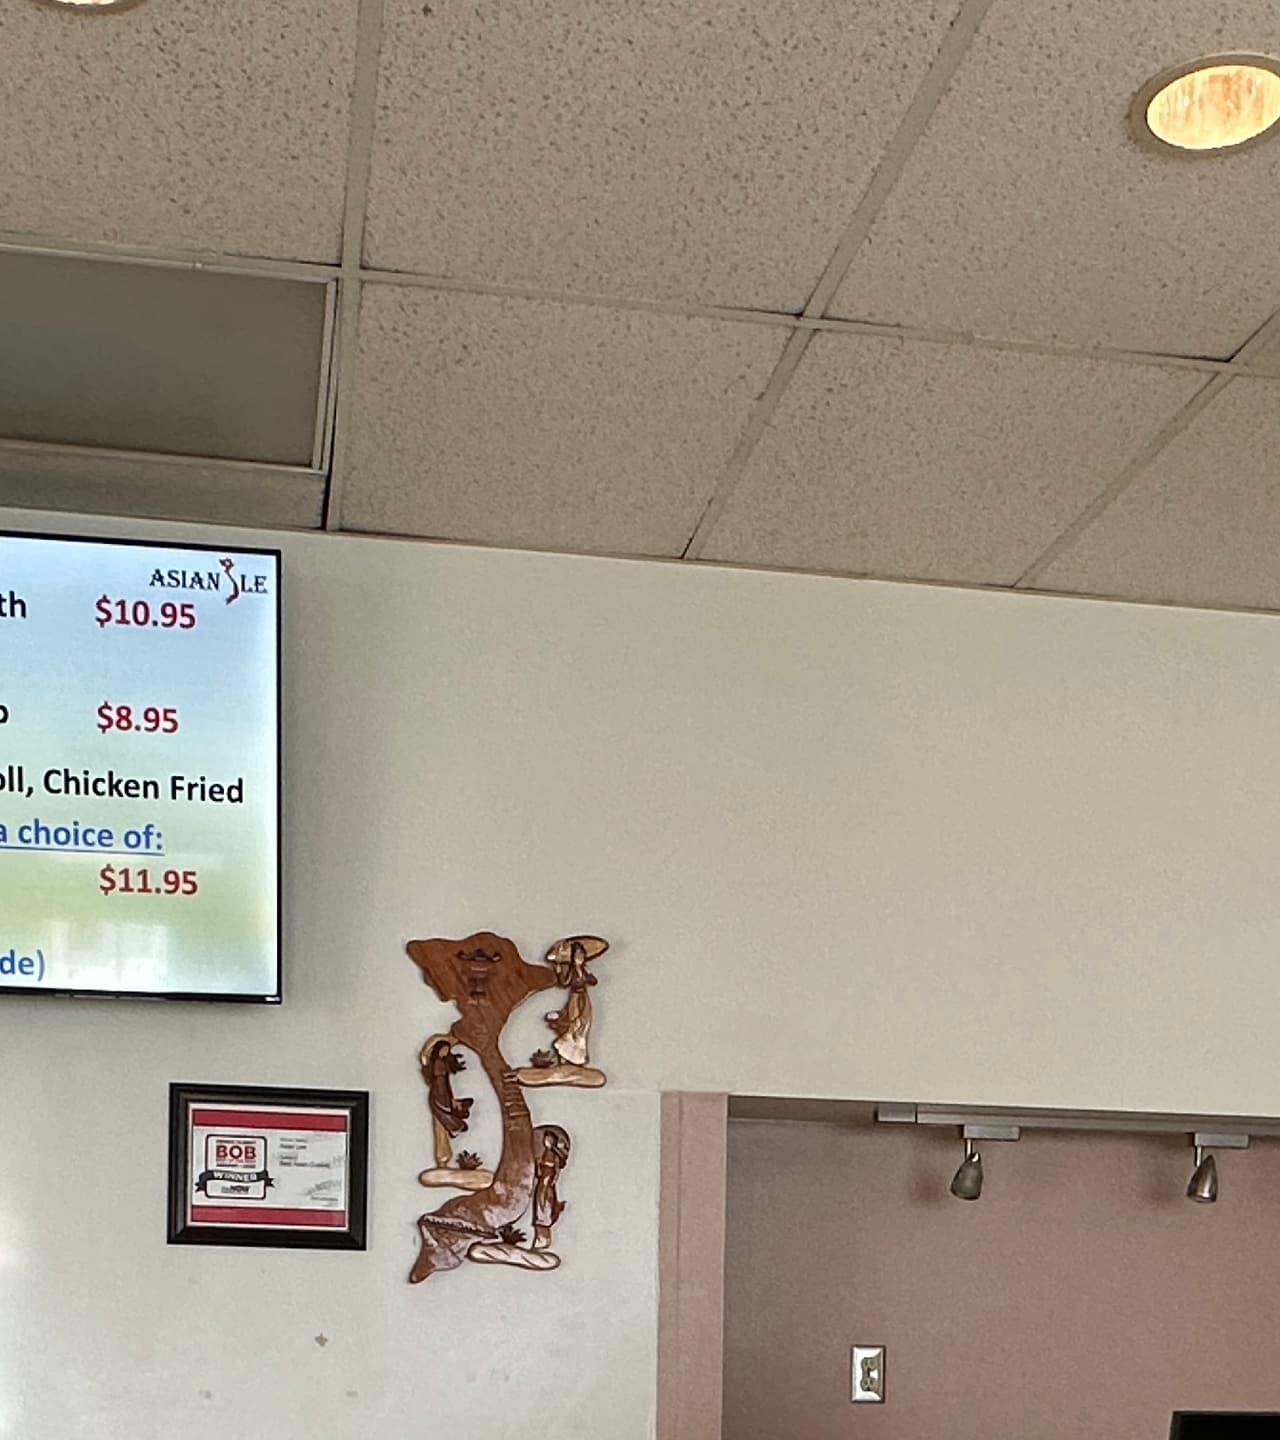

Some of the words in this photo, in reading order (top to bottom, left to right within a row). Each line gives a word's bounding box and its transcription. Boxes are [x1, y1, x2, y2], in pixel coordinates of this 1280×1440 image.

[149, 568, 220, 592] ASIAN
[94, 594, 197, 629] $10.95
[96, 701, 179, 734] $8.95
[43, 769, 160, 800] Chicken
[170, 776, 244, 804] Fried
[18, 818, 114, 848] choice
[123, 824, 164, 851] of:
[99, 864, 199, 896] $11.95
[215, 1145, 257, 1160] BOB
[213, 1171, 258, 1182] WINNER
